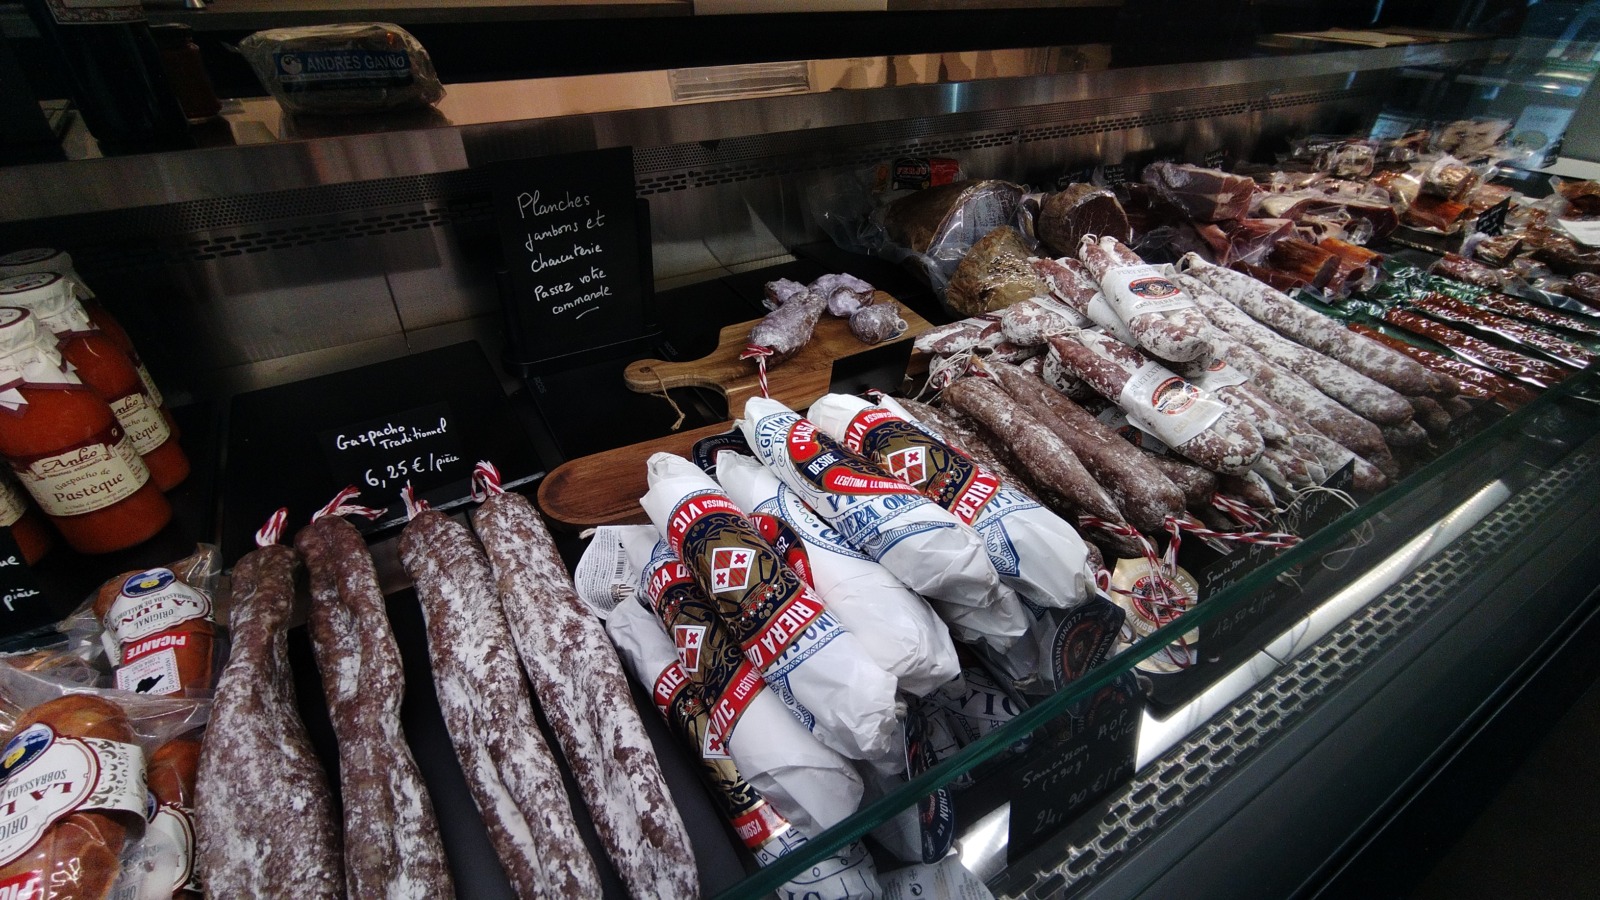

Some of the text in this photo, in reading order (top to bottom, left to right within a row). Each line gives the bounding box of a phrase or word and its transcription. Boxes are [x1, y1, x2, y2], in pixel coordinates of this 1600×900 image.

[517, 189, 590, 219] Planches
[586, 210, 606, 229] et
[534, 266, 607, 302] Passez votre
[551, 285, 613, 315] commande
[336, 422, 405, 451] Gazpacho
[379, 417, 447, 450] Traditionnel
[41, 447, 97, 473] Anko
[100, 467, 111, 476] de
[807, 452, 840, 476] DESDE
[53, 472, 126, 503] Pastèque
[834, 474, 867, 489] LEGÍTIMA
[672, 502, 704, 534] VIC
[172, 598, 199, 608] LA
[133, 608, 174, 629] ORIGINAL
[760, 600, 816, 656] RIERA
[126, 635, 186, 661] PICANTE
[711, 698, 736, 738] VIC
[7, 769, 67, 800] SOBRASSADA
[29, 781, 74, 801] LA
